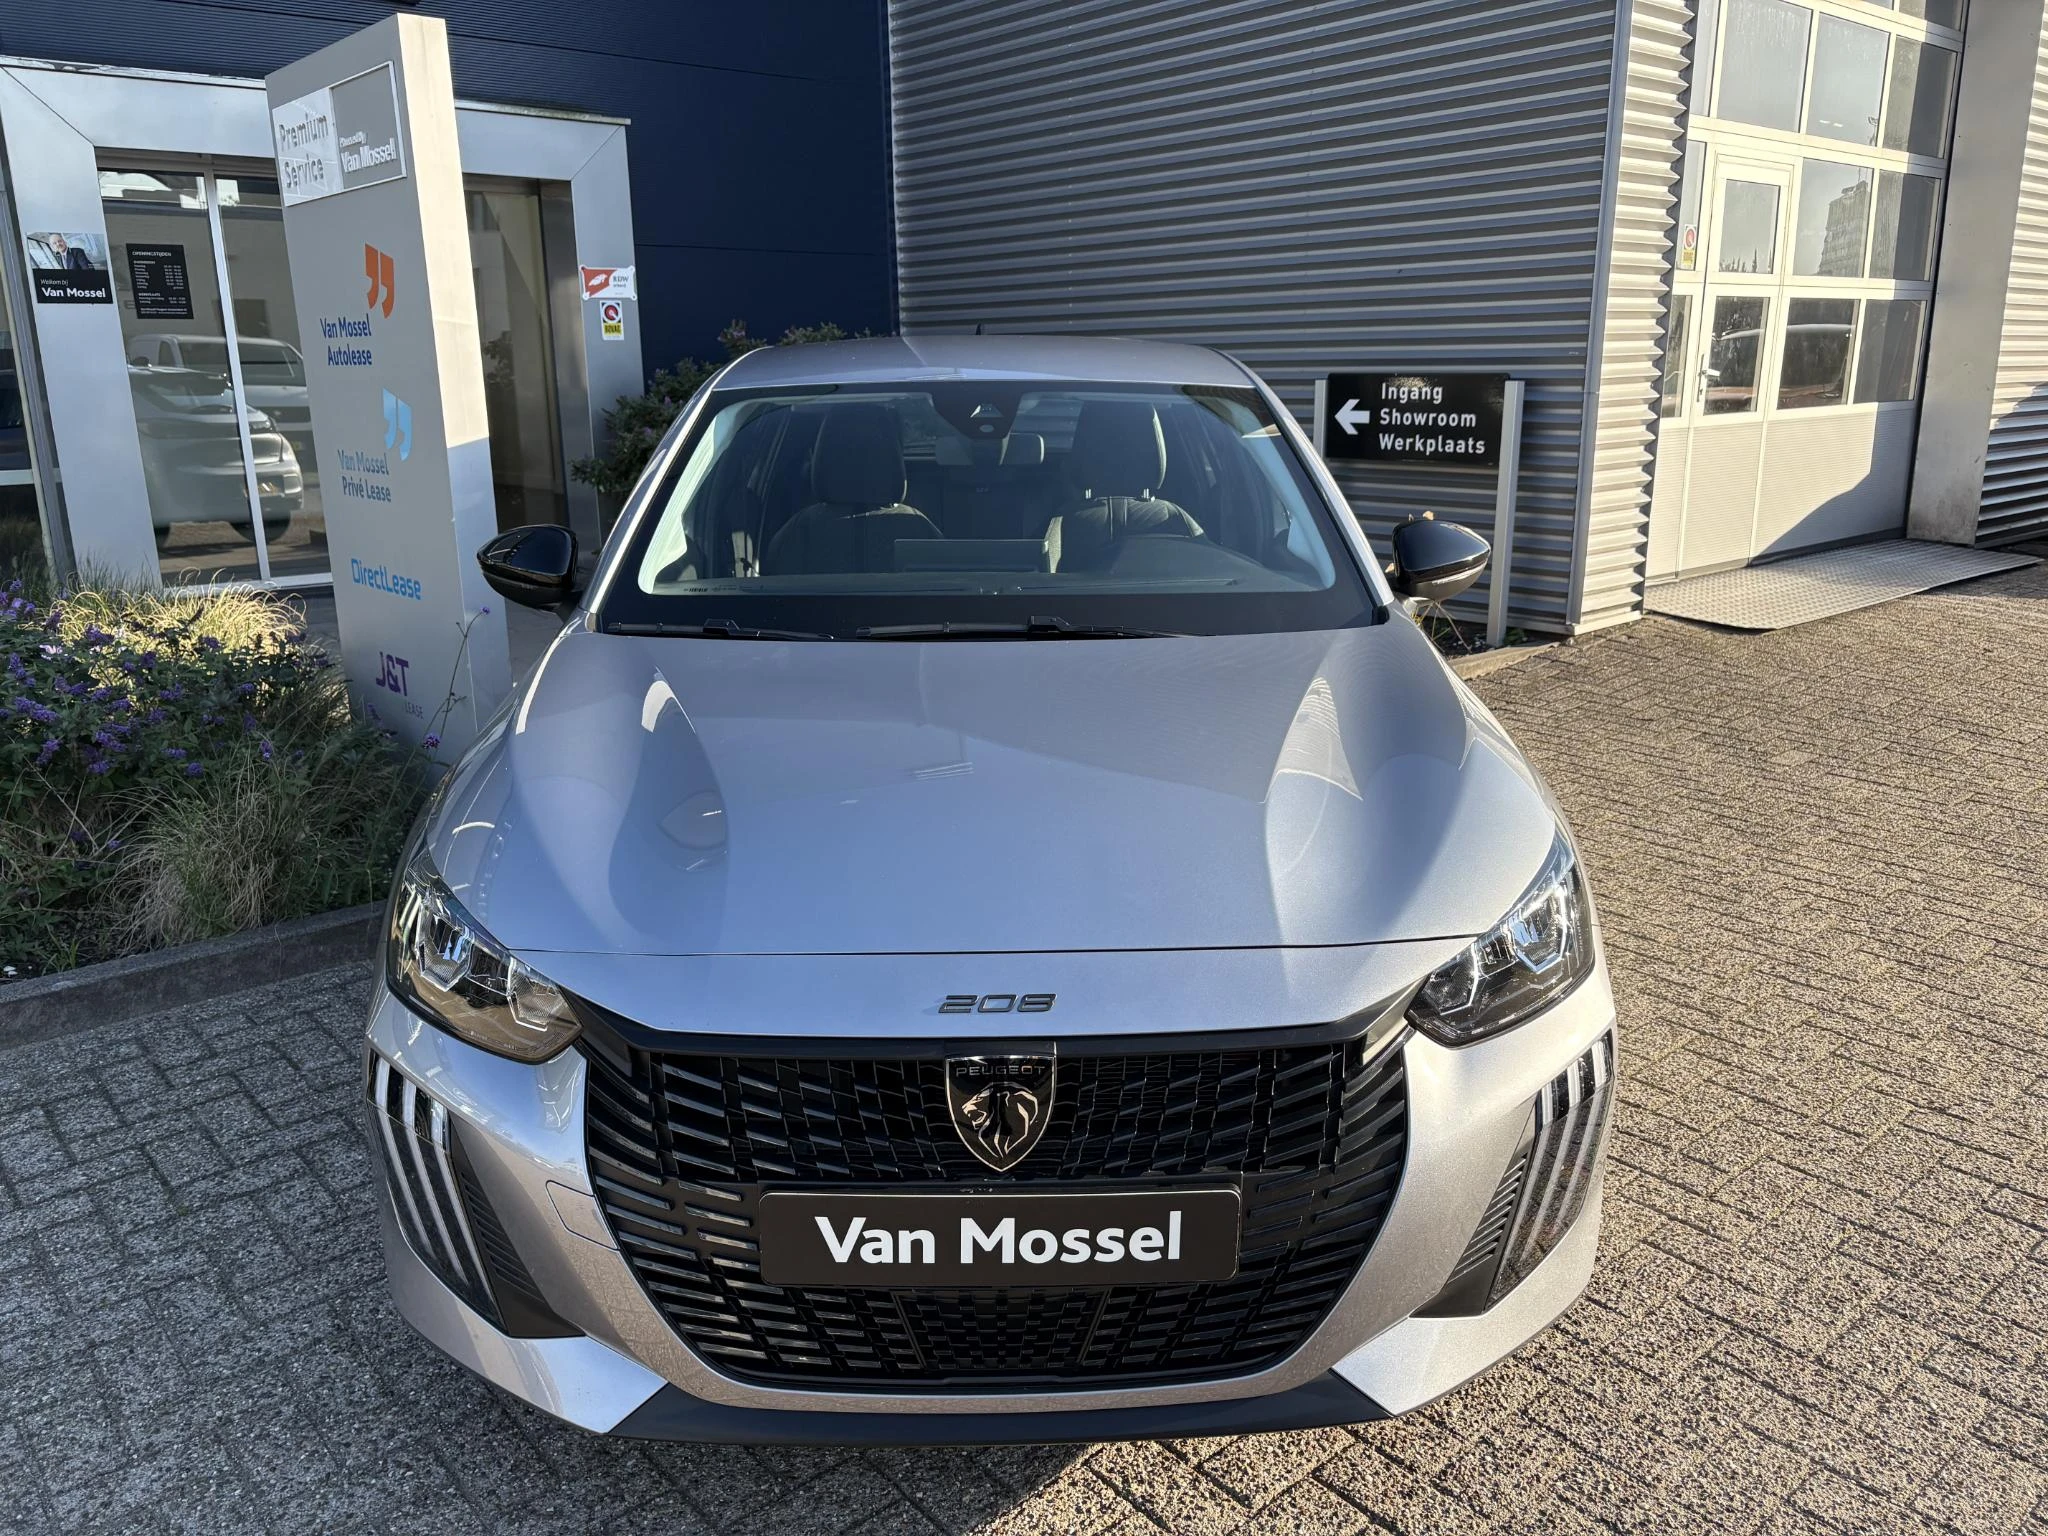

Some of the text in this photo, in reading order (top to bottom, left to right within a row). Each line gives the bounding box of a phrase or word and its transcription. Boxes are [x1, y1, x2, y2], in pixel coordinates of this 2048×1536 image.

[279, 112, 329, 151] Premium
[341, 138, 396, 172] Van Mossel
[284, 154, 324, 188] Service
[41, 287, 106, 298] Van Mossel
[320, 313, 372, 339] Van Mossel
[328, 343, 372, 366] Autolease
[1381, 382, 1443, 404] Ingang
[1380, 408, 1476, 427] Showroom
[1379, 433, 1486, 455] Werkplaats
[337, 449, 389, 475] Van Mossel
[341, 475, 391, 502] Privé Lease
[351, 558, 422, 600] DirectLease
[376, 651, 410, 696] J&T
[938, 993, 1057, 1014] 208
[956, 1065, 1046, 1077] PEUGEOT
[814, 1210, 1182, 1264] Van Mossel
